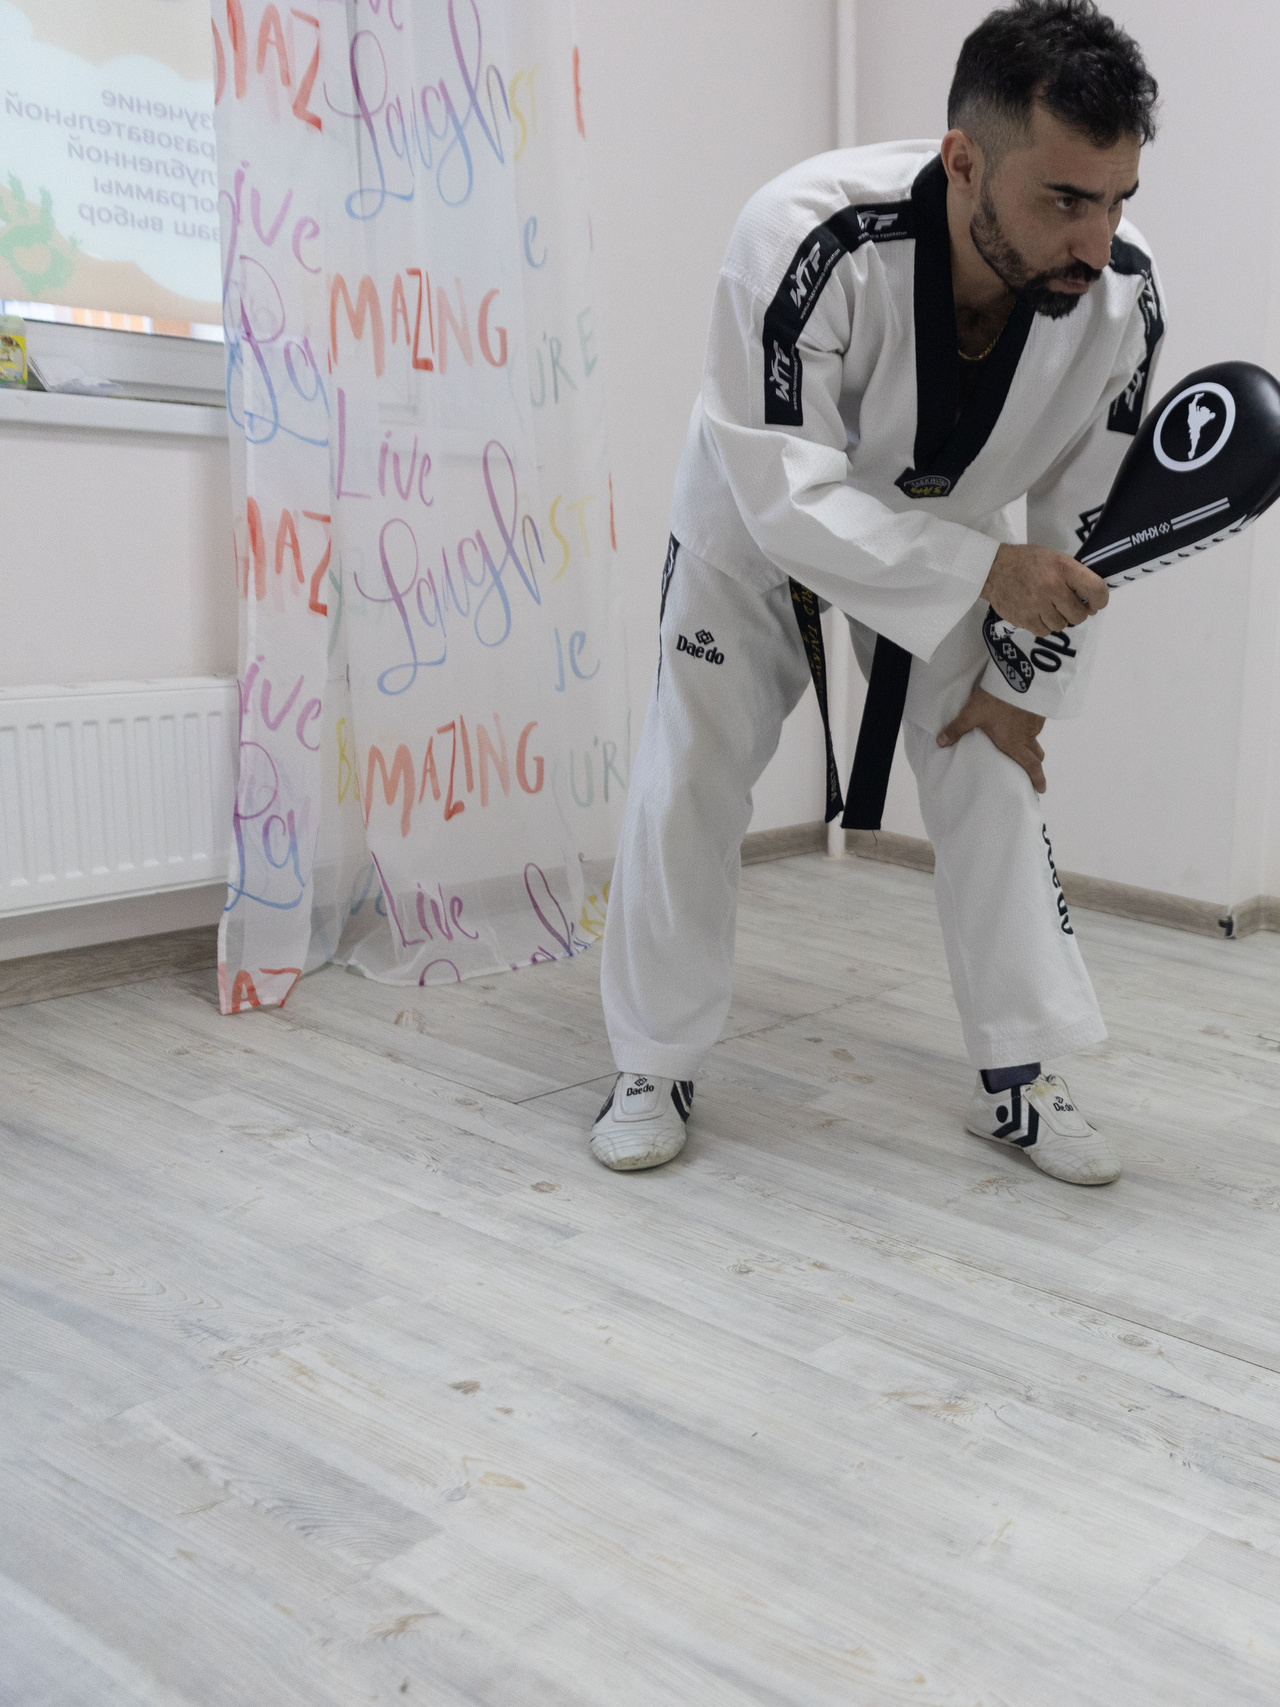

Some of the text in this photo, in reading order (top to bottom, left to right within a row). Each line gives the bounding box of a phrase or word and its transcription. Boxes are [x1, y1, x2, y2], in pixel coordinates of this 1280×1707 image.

[336, 386, 434, 507] Live
[1131, 525, 1159, 547] KHAN
[676, 633, 725, 665] Daedo
[363, 711, 545, 838] MAZING
[371, 851, 479, 948] Live
